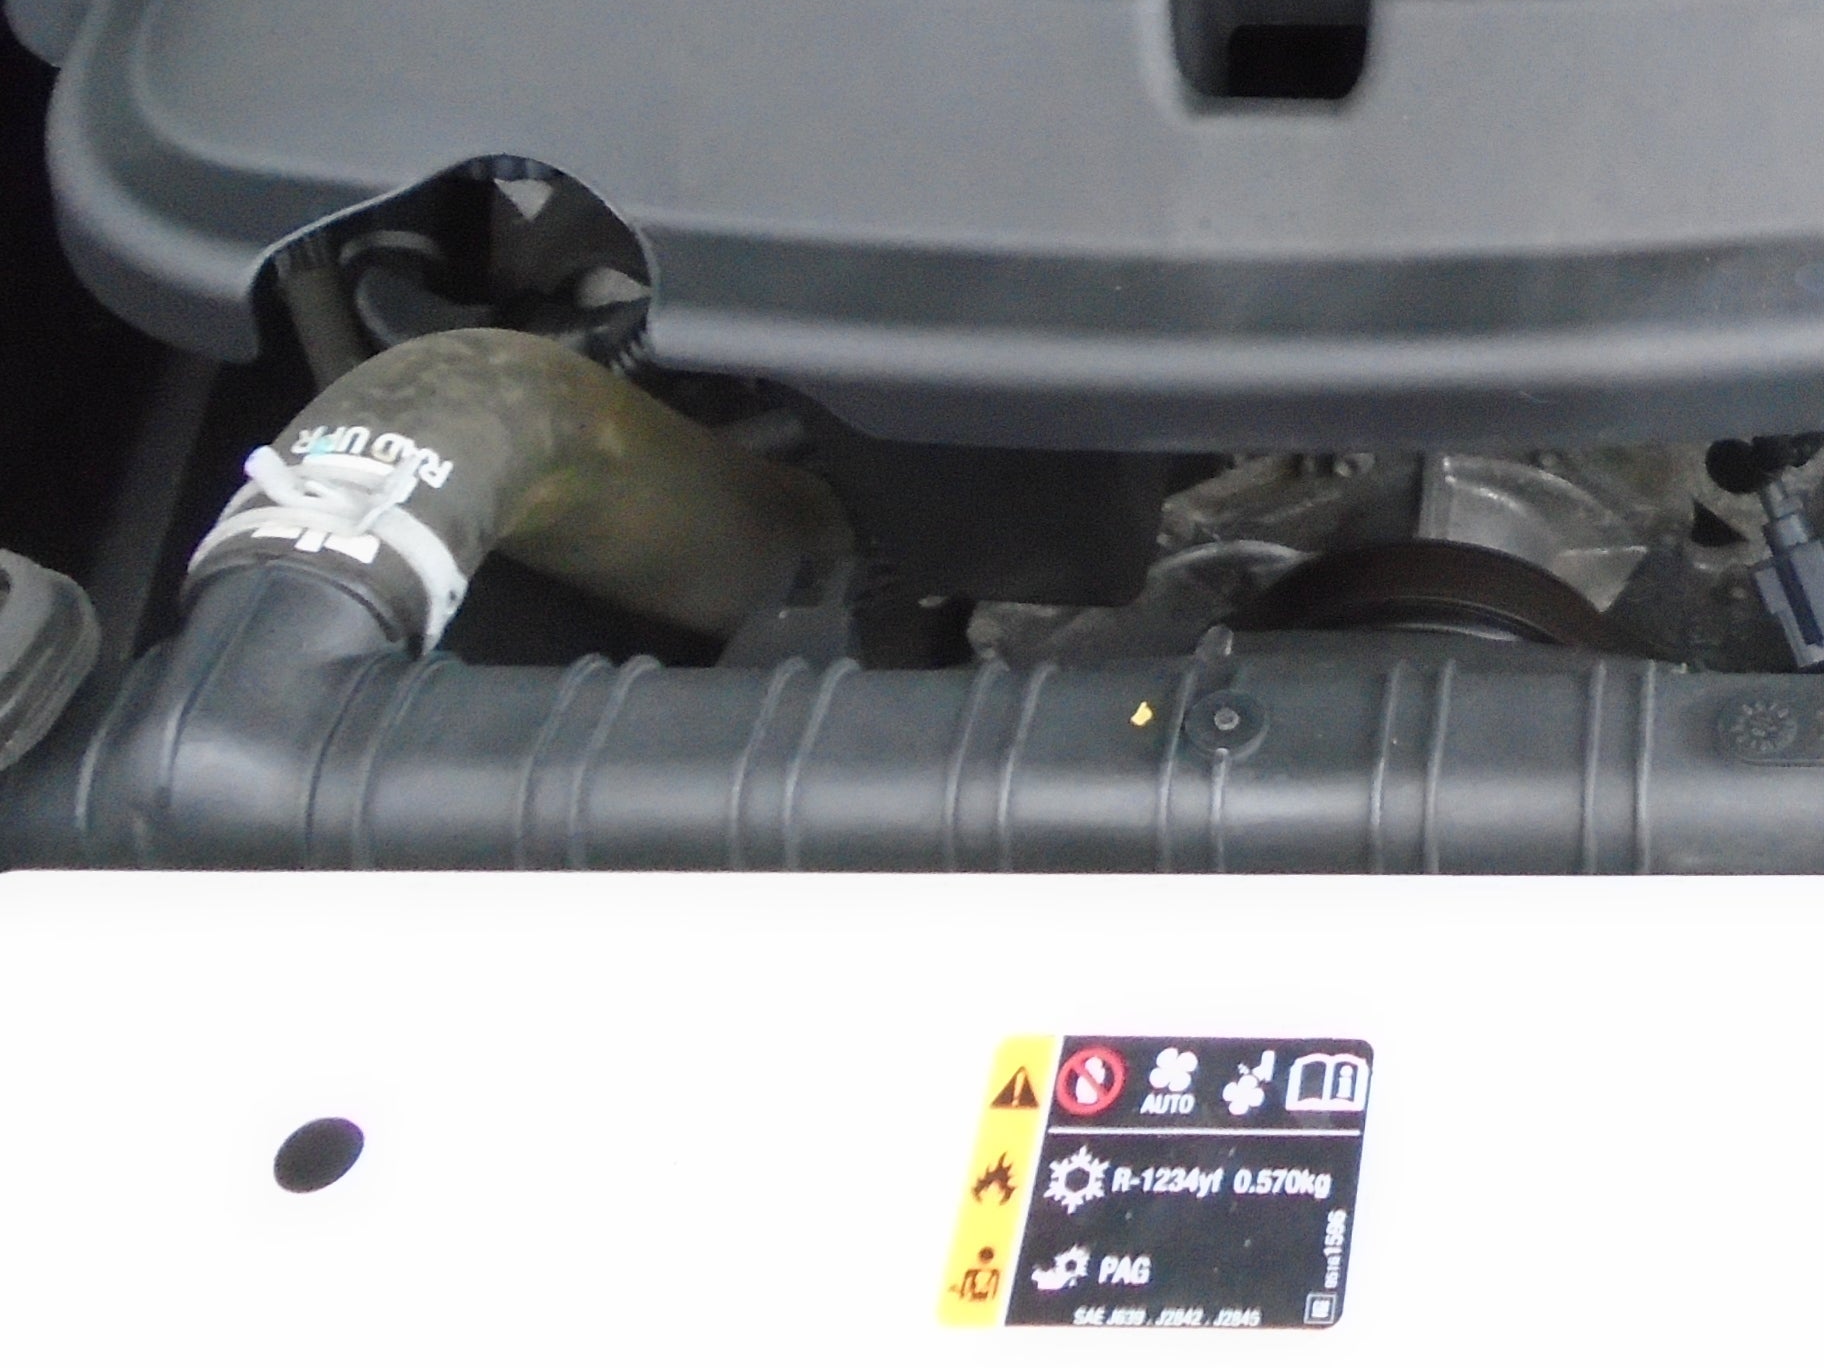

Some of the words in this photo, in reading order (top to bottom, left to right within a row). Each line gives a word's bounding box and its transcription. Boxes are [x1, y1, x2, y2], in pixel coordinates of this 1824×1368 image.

[1140, 1093, 1195, 1116] AUTO
[1111, 1166, 1224, 1198] R-1234yf
[1232, 1167, 1333, 1199] 0.570kg
[1097, 1255, 1151, 1285] PAG
[1073, 1306, 1105, 1325] SAE
